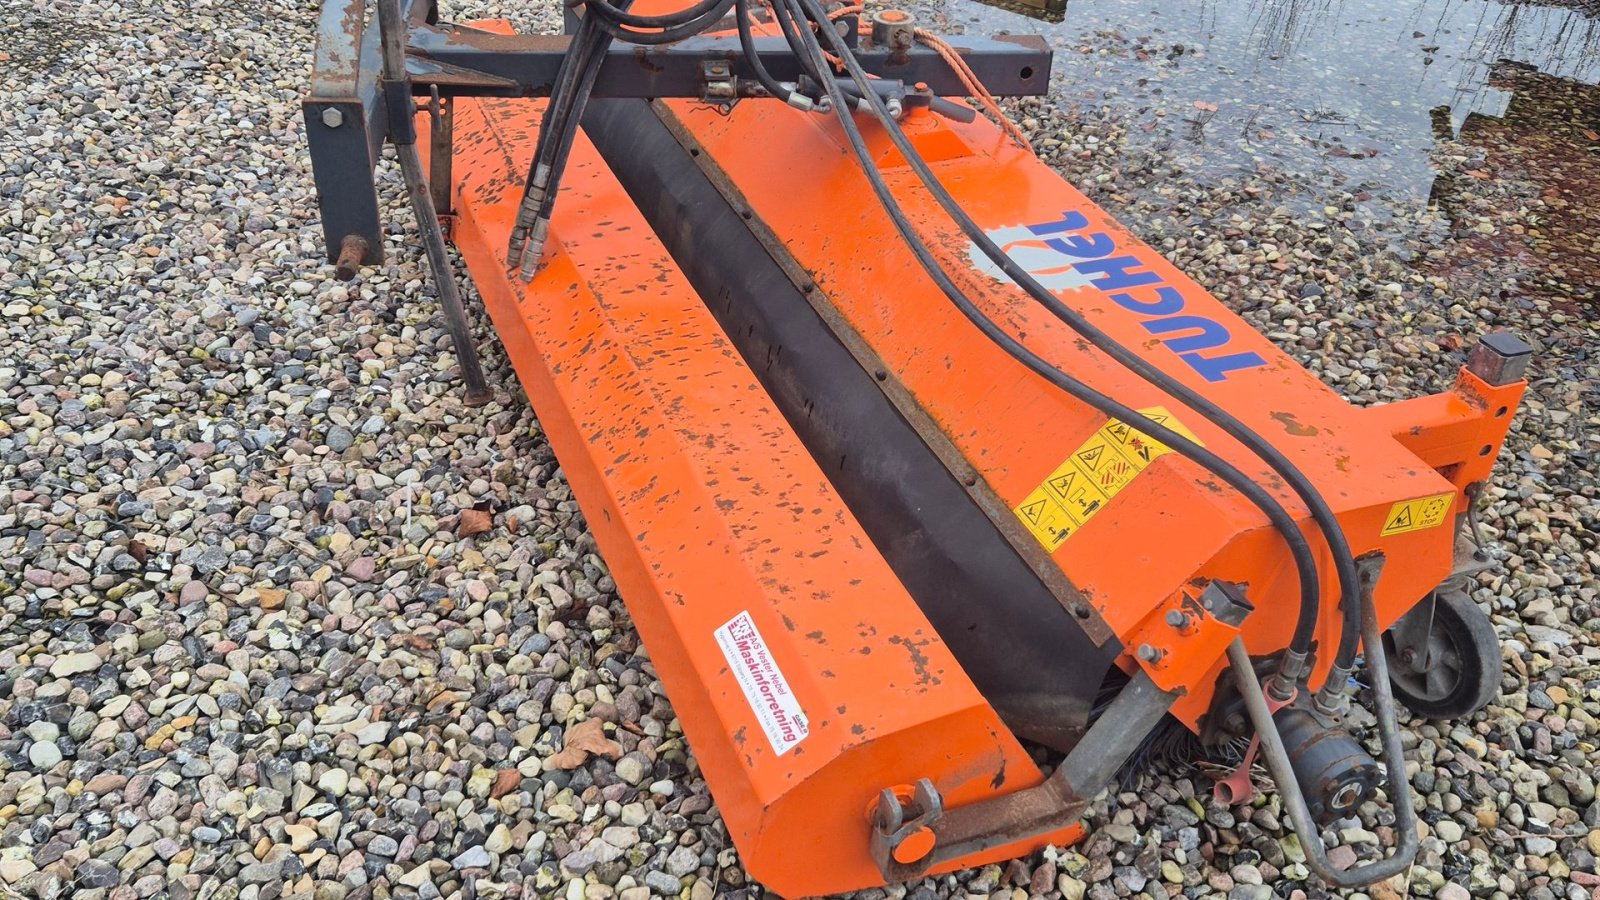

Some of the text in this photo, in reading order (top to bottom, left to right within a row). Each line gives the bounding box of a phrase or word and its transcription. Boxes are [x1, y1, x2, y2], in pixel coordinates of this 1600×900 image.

[1419, 517, 1437, 526] STOP
[749, 637, 787, 696] A/S Vester Nebel
[736, 641, 797, 742] Maskinforretning
[795, 714, 805, 729] CASE
